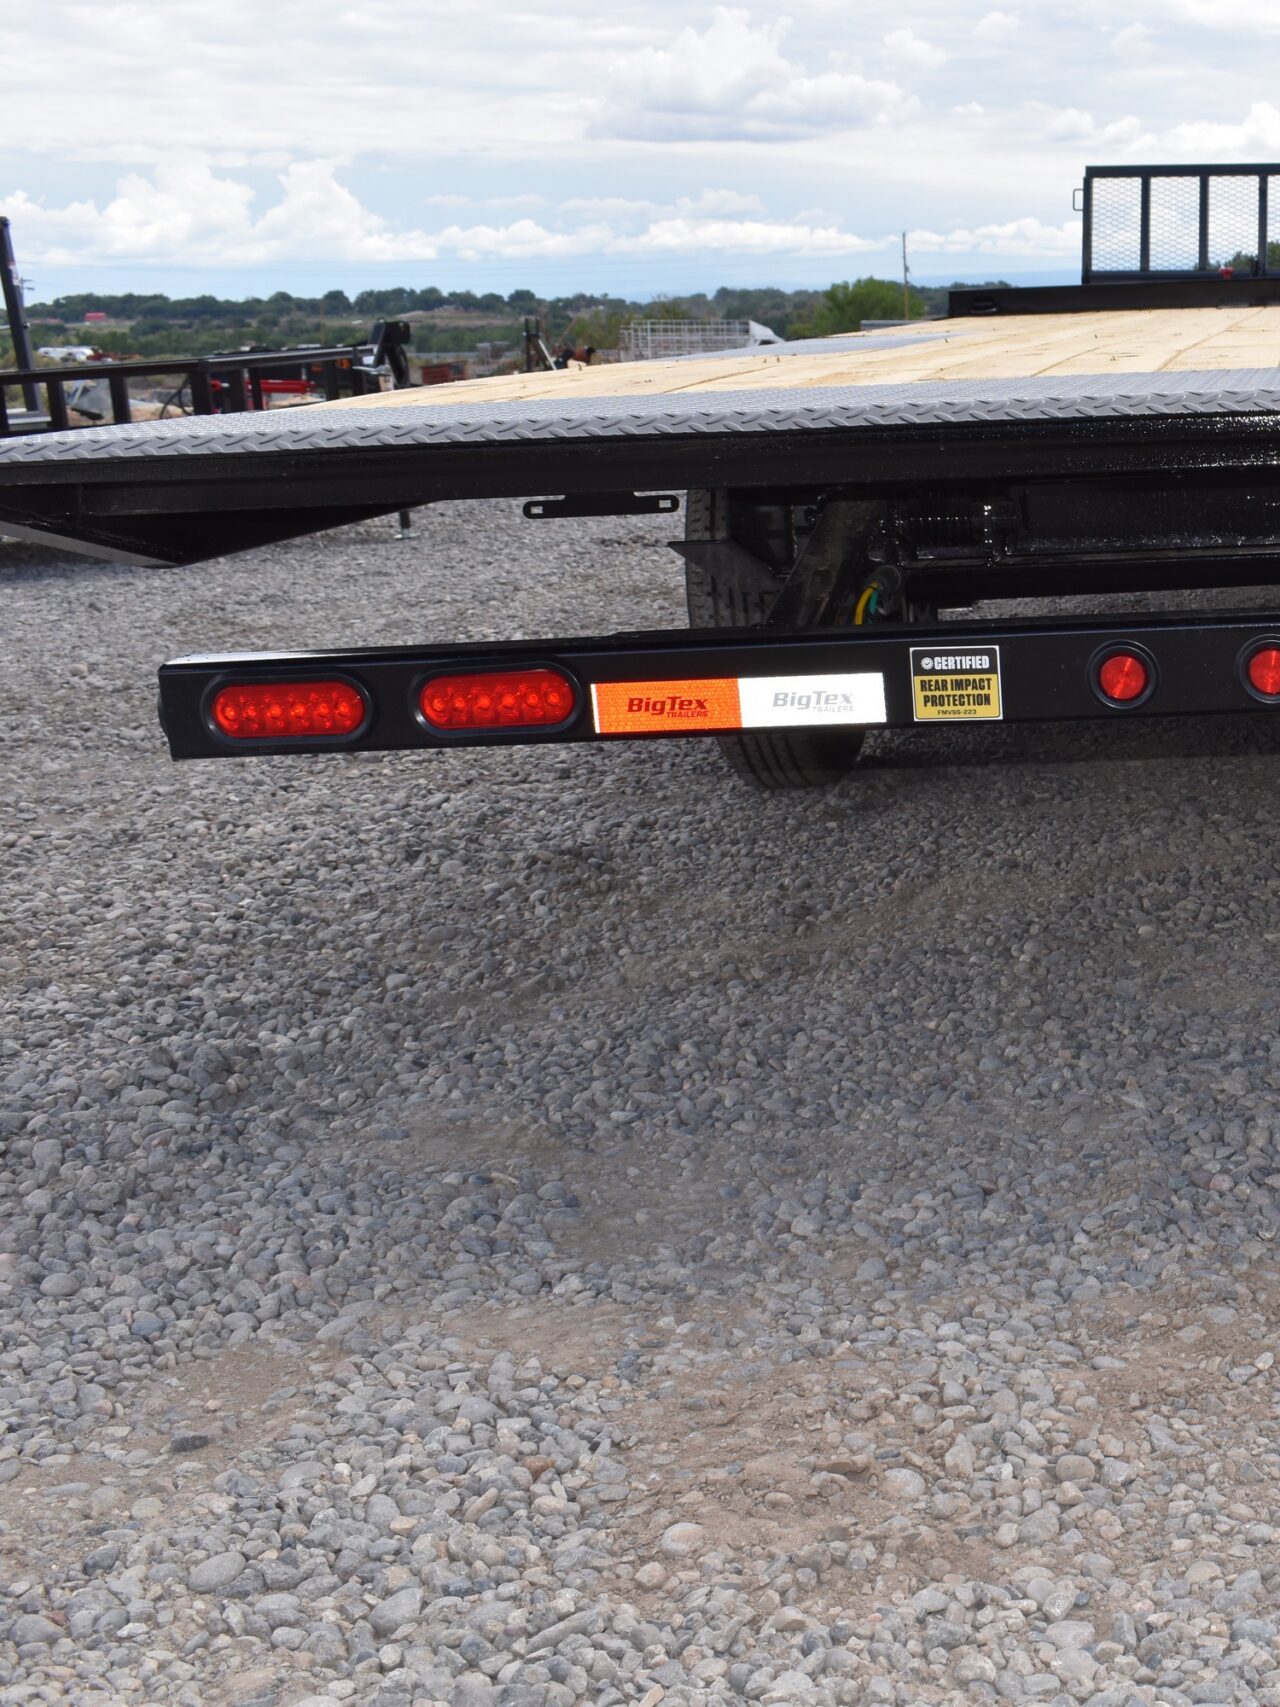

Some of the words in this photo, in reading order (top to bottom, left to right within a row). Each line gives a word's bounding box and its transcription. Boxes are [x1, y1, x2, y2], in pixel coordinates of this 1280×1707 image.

[934, 655, 990, 670] CERTIFIED
[920, 679, 948, 692] REAR
[950, 678, 992, 691] IMPACT
[627, 696, 708, 715] BigTex
[773, 690, 854, 710] BigTex
[923, 693, 991, 707] PROTECTION
[667, 710, 709, 718] TRAILERS
[812, 705, 854, 713] TRAILERS
